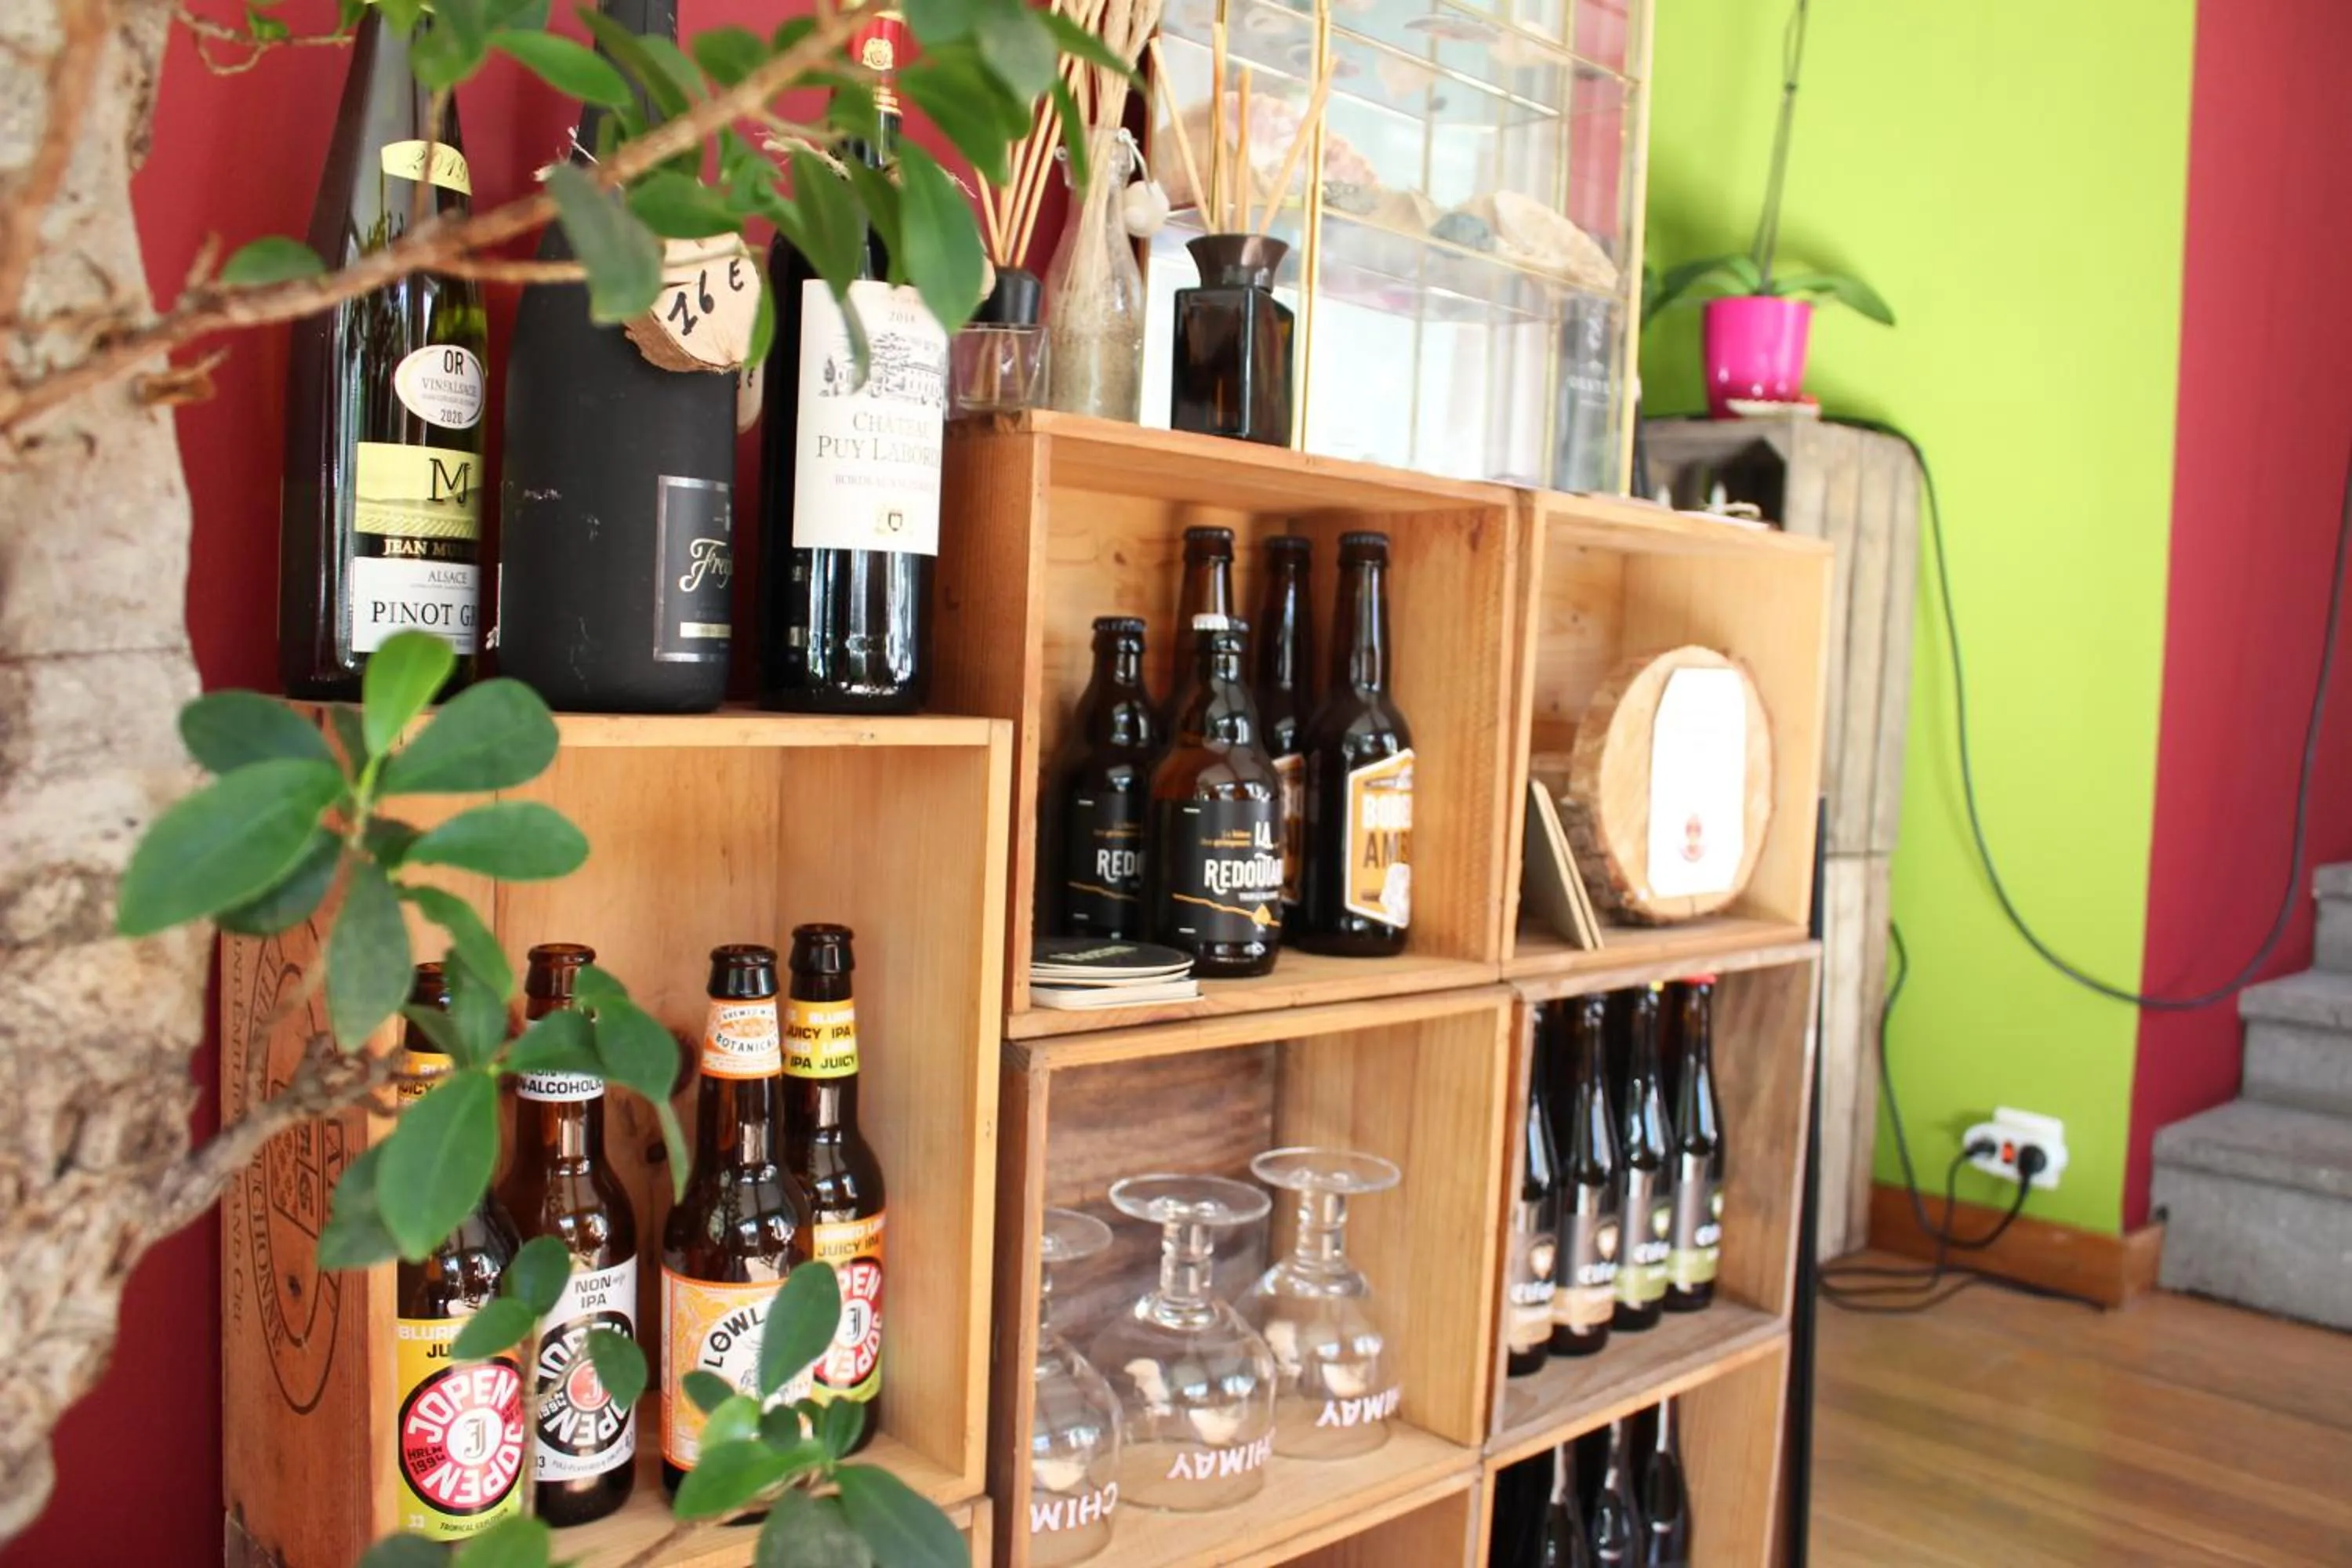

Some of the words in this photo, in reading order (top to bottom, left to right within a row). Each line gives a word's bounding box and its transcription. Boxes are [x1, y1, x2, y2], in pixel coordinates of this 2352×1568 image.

[443, 349, 464, 376] OR
[440, 408, 463, 424] 2020
[816, 435, 866, 459] PUY
[383, 539, 427, 557] JEAN
[427, 569, 468, 586] ALSACE
[372, 601, 453, 626] PINOT
[1254, 821, 1274, 850] LA
[831, 1025, 851, 1039] IPA
[790, 1055, 812, 1069] IPA
[816, 1237, 861, 1258] JUICY
[581, 1291, 608, 1309] IPA
[407, 1368, 520, 1445] JOPEN
[421, 1422, 524, 1504] JOPEN
